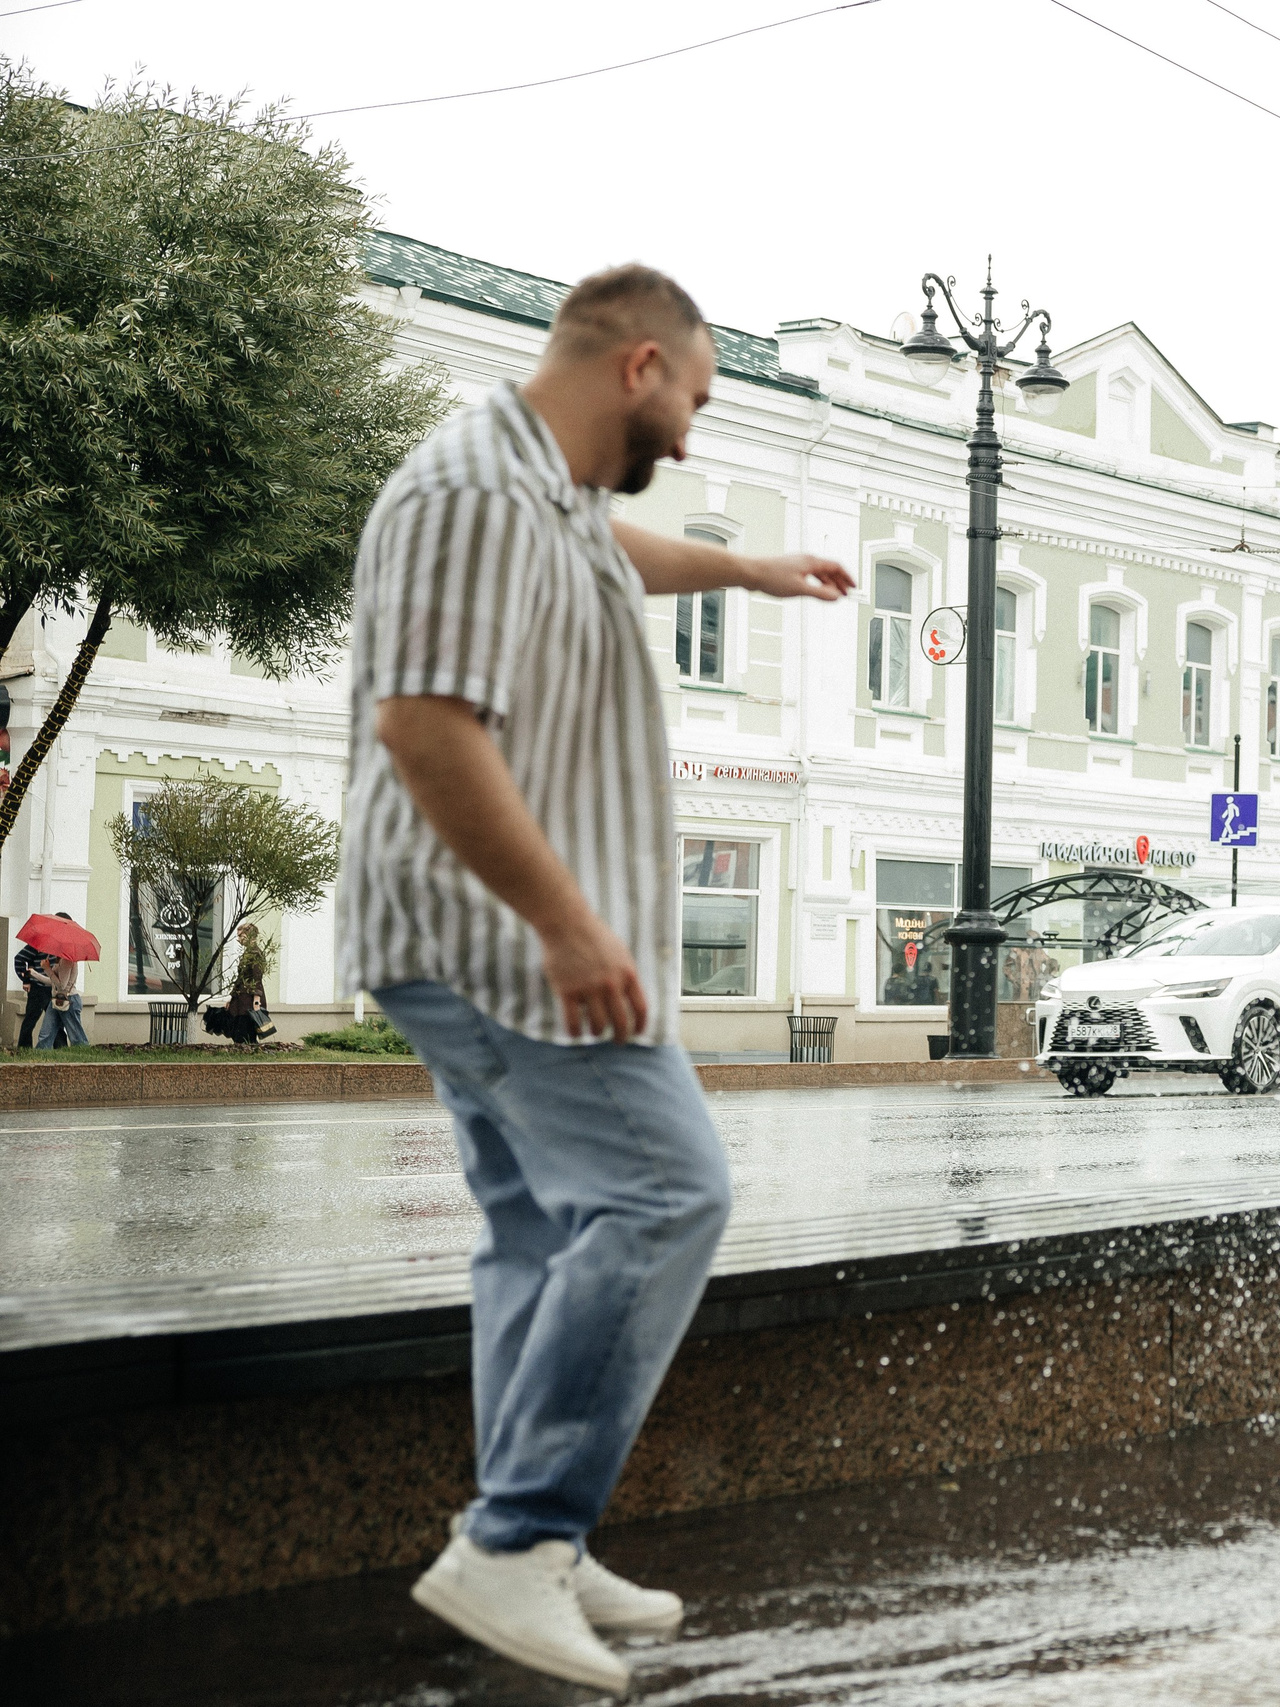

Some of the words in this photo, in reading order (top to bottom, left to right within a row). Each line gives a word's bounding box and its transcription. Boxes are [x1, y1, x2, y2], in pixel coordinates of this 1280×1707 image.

[717, 765, 738, 779] сеть
[741, 766, 800, 784] хинкальных
[1040, 841, 1136, 865] МИДИЙНОЕ
[1149, 849, 1197, 868] МЕСТО
